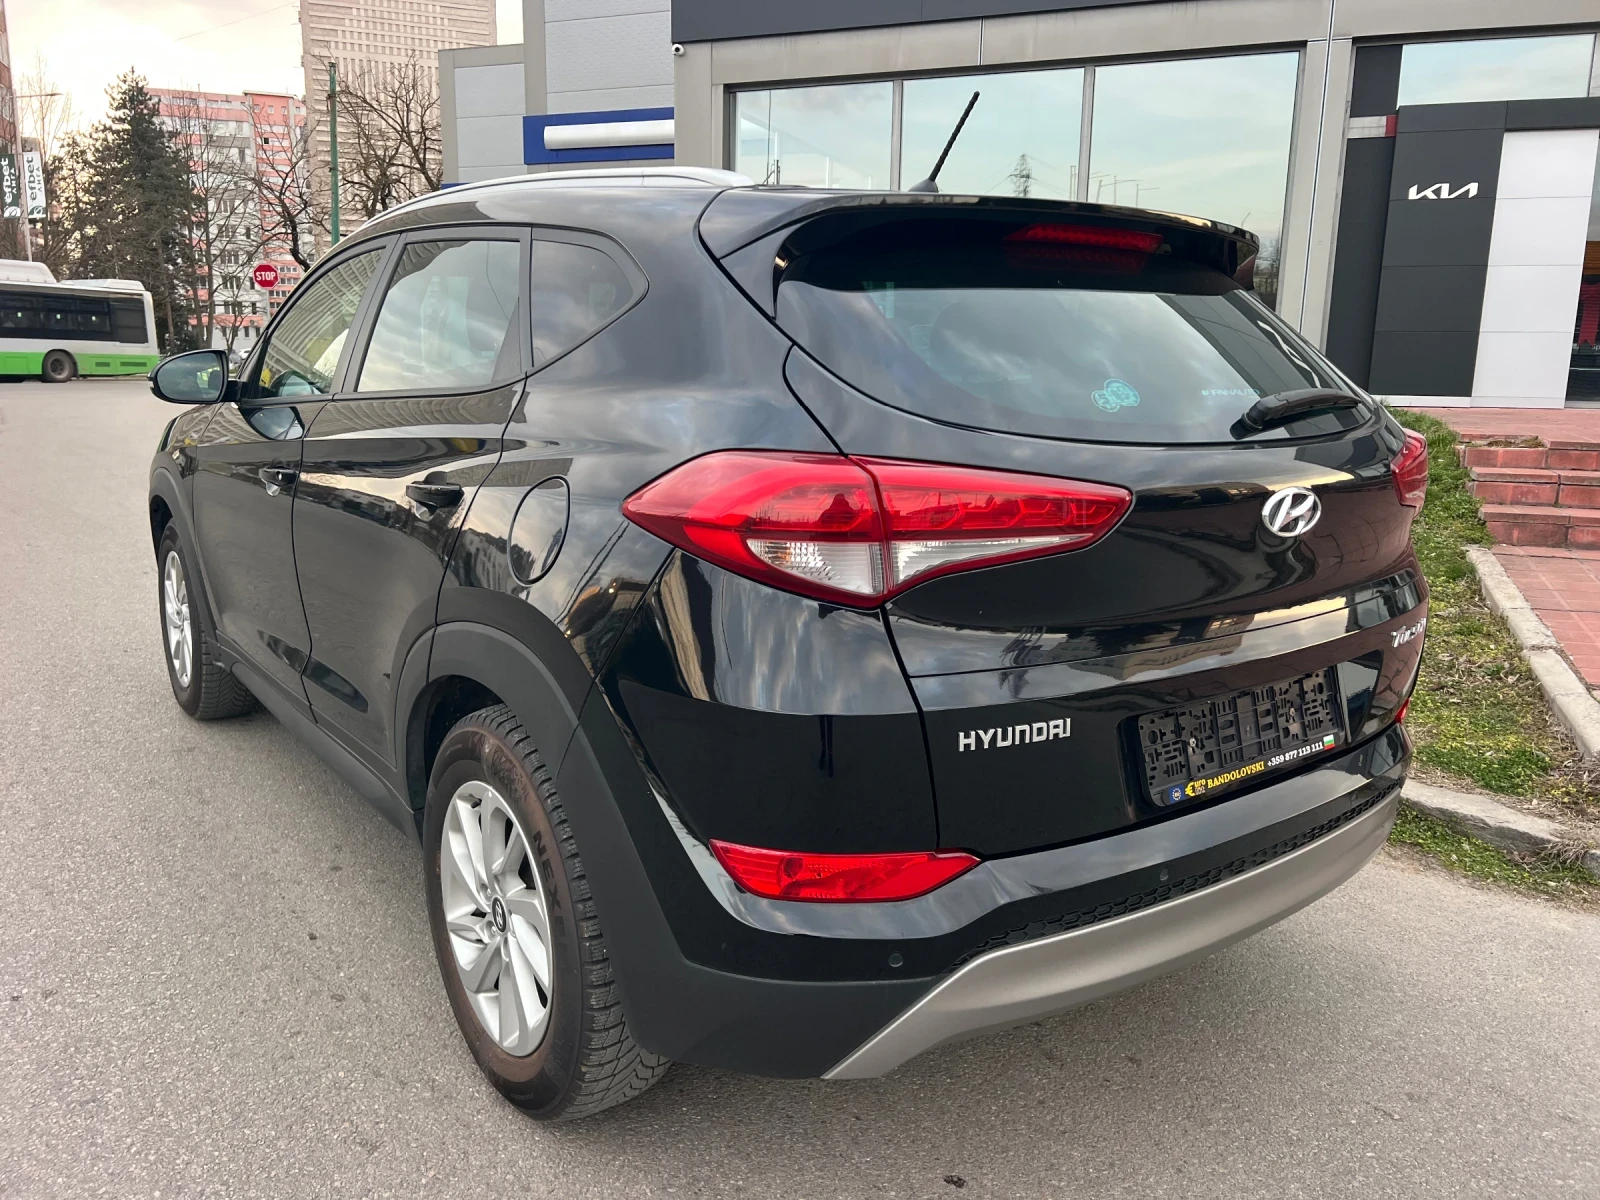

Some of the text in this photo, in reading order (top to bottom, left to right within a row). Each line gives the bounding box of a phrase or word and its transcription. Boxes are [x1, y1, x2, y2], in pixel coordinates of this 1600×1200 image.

[0, 157, 13, 204] efbet
[26, 156, 37, 201] efbet
[255, 271, 276, 281] STOP
[958, 718, 1071, 752] HYUNDAI
[1207, 761, 1265, 789] BANDOLOVSKI
[1267, 755, 1285, 767] +359
[1285, 750, 1298, 761] 877
[1298, 746, 1311, 757] 113
[1311, 741, 1324, 752] 111
